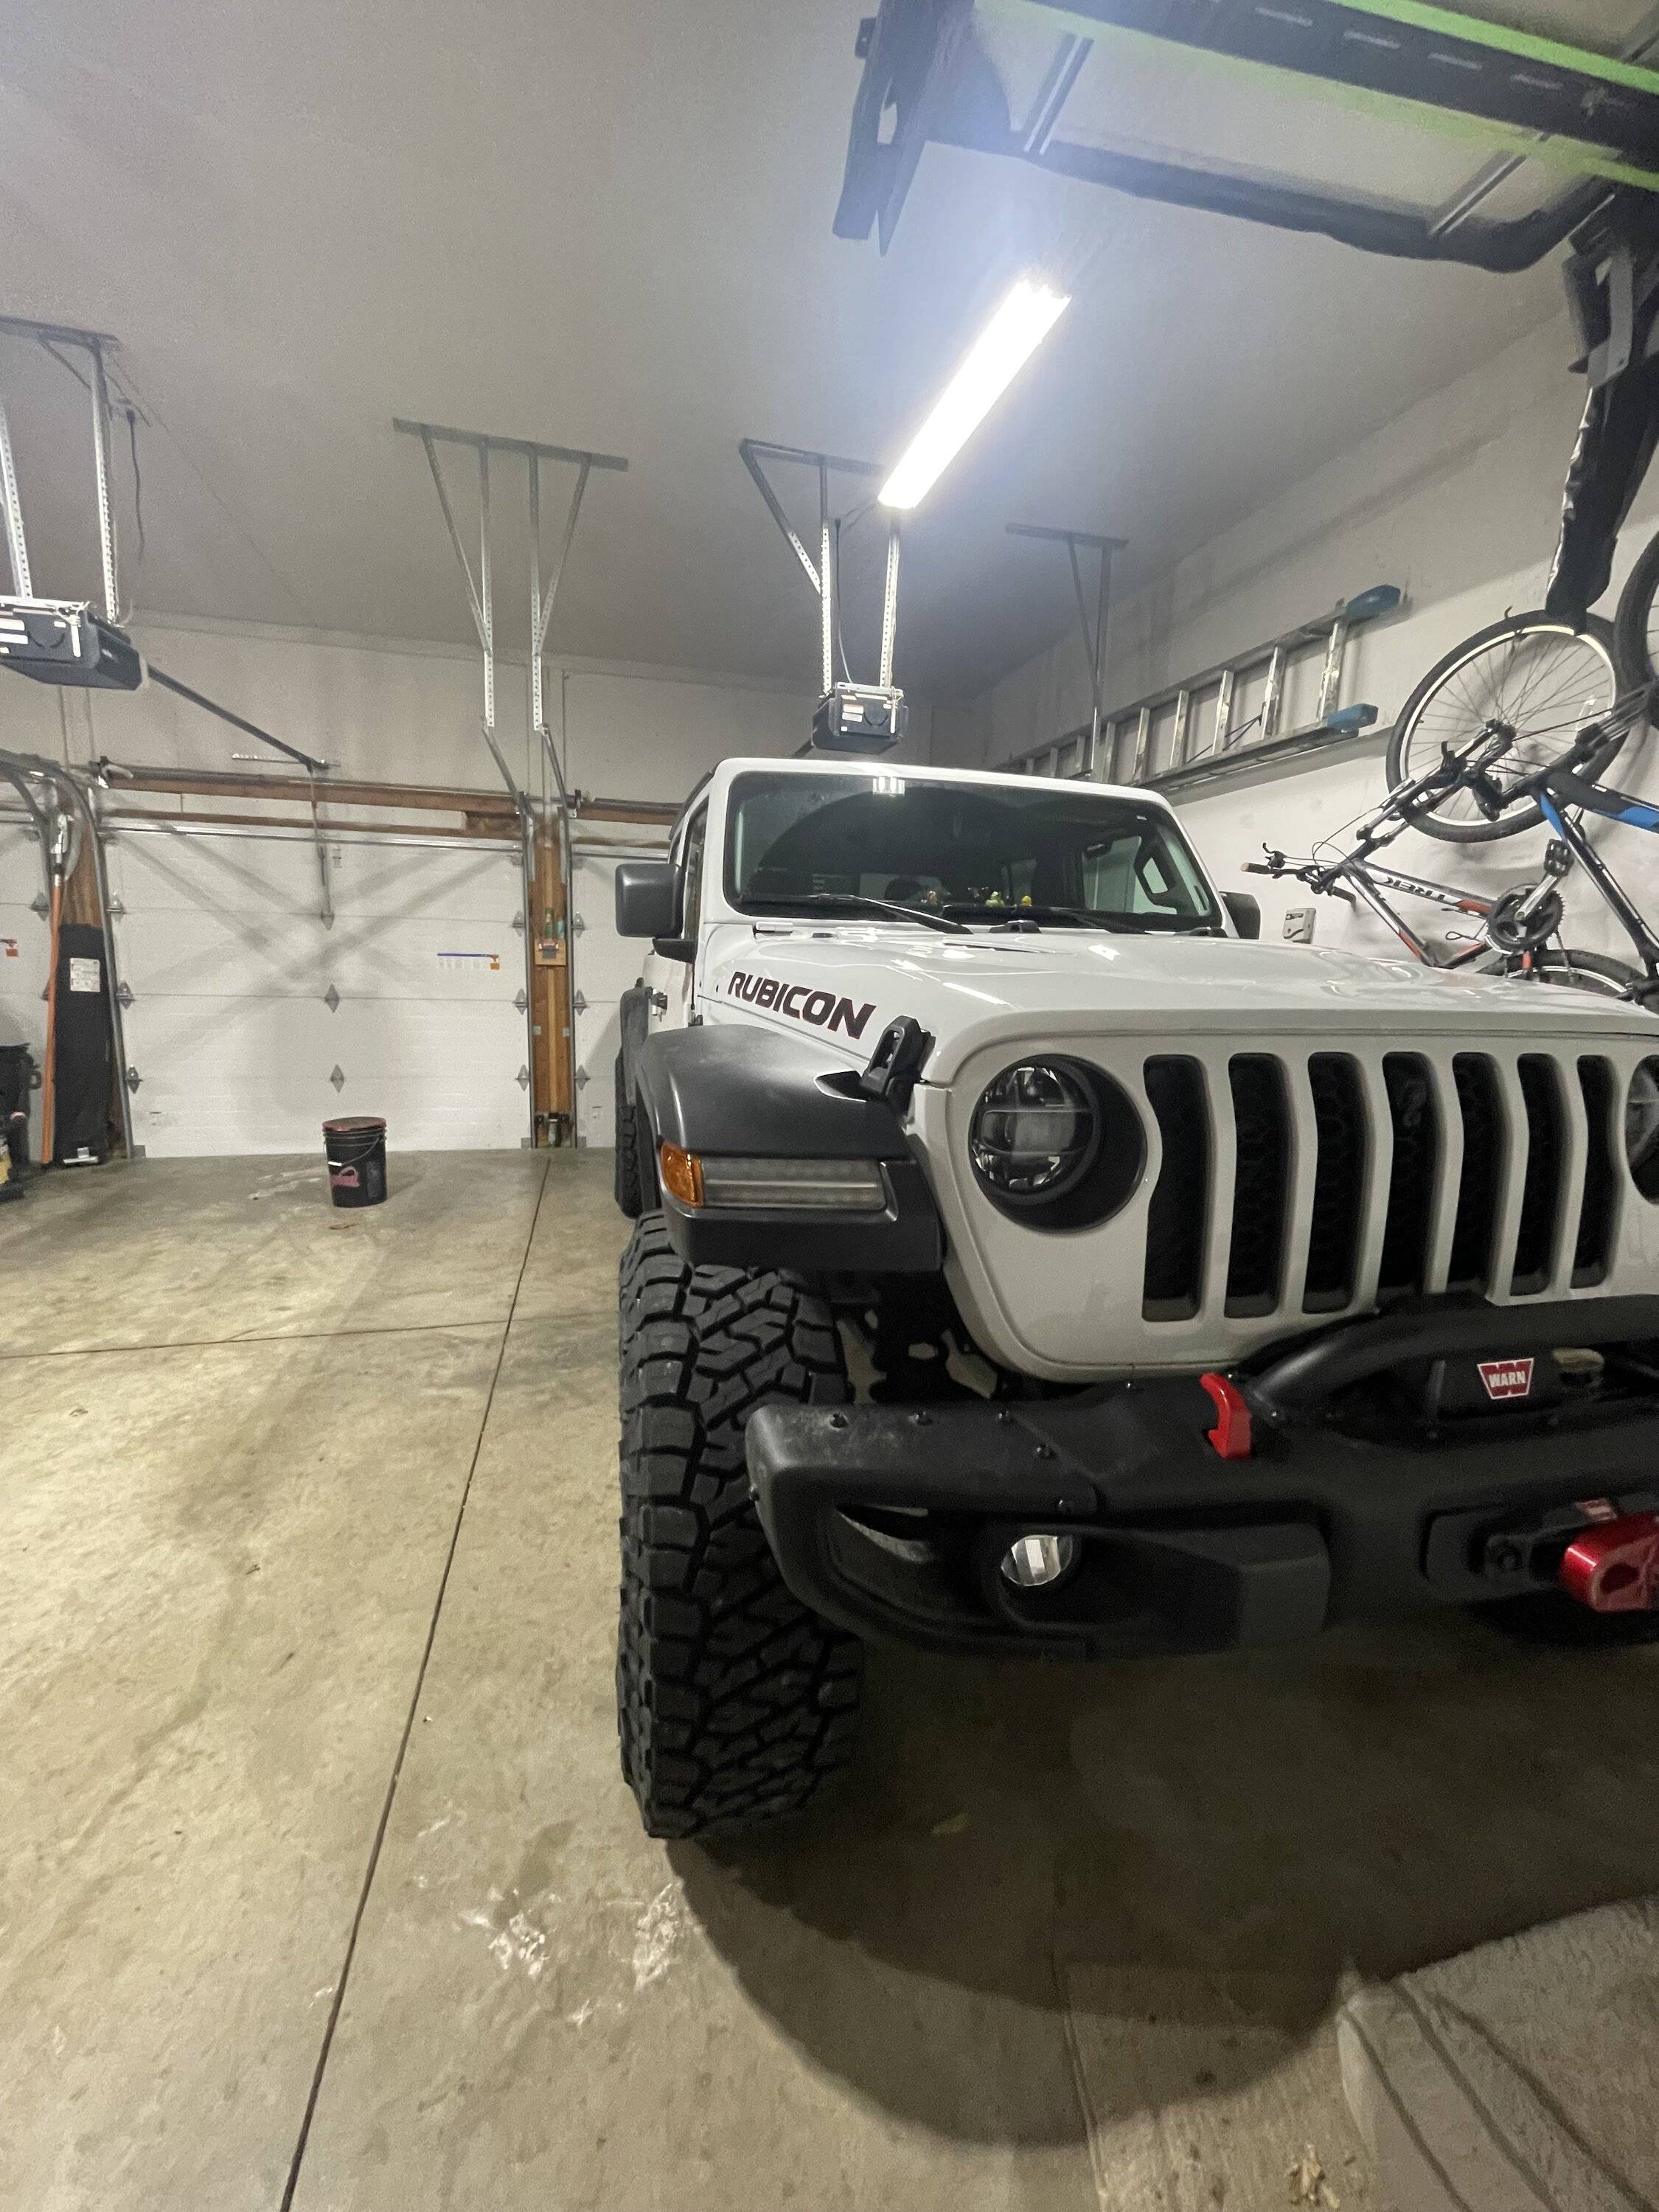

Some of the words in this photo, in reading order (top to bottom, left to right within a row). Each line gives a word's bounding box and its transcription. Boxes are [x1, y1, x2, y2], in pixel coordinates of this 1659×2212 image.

[1383, 876, 1447, 901] TREK
[727, 971, 877, 1040] RUBICON
[1488, 1371, 1526, 1388] WARN
